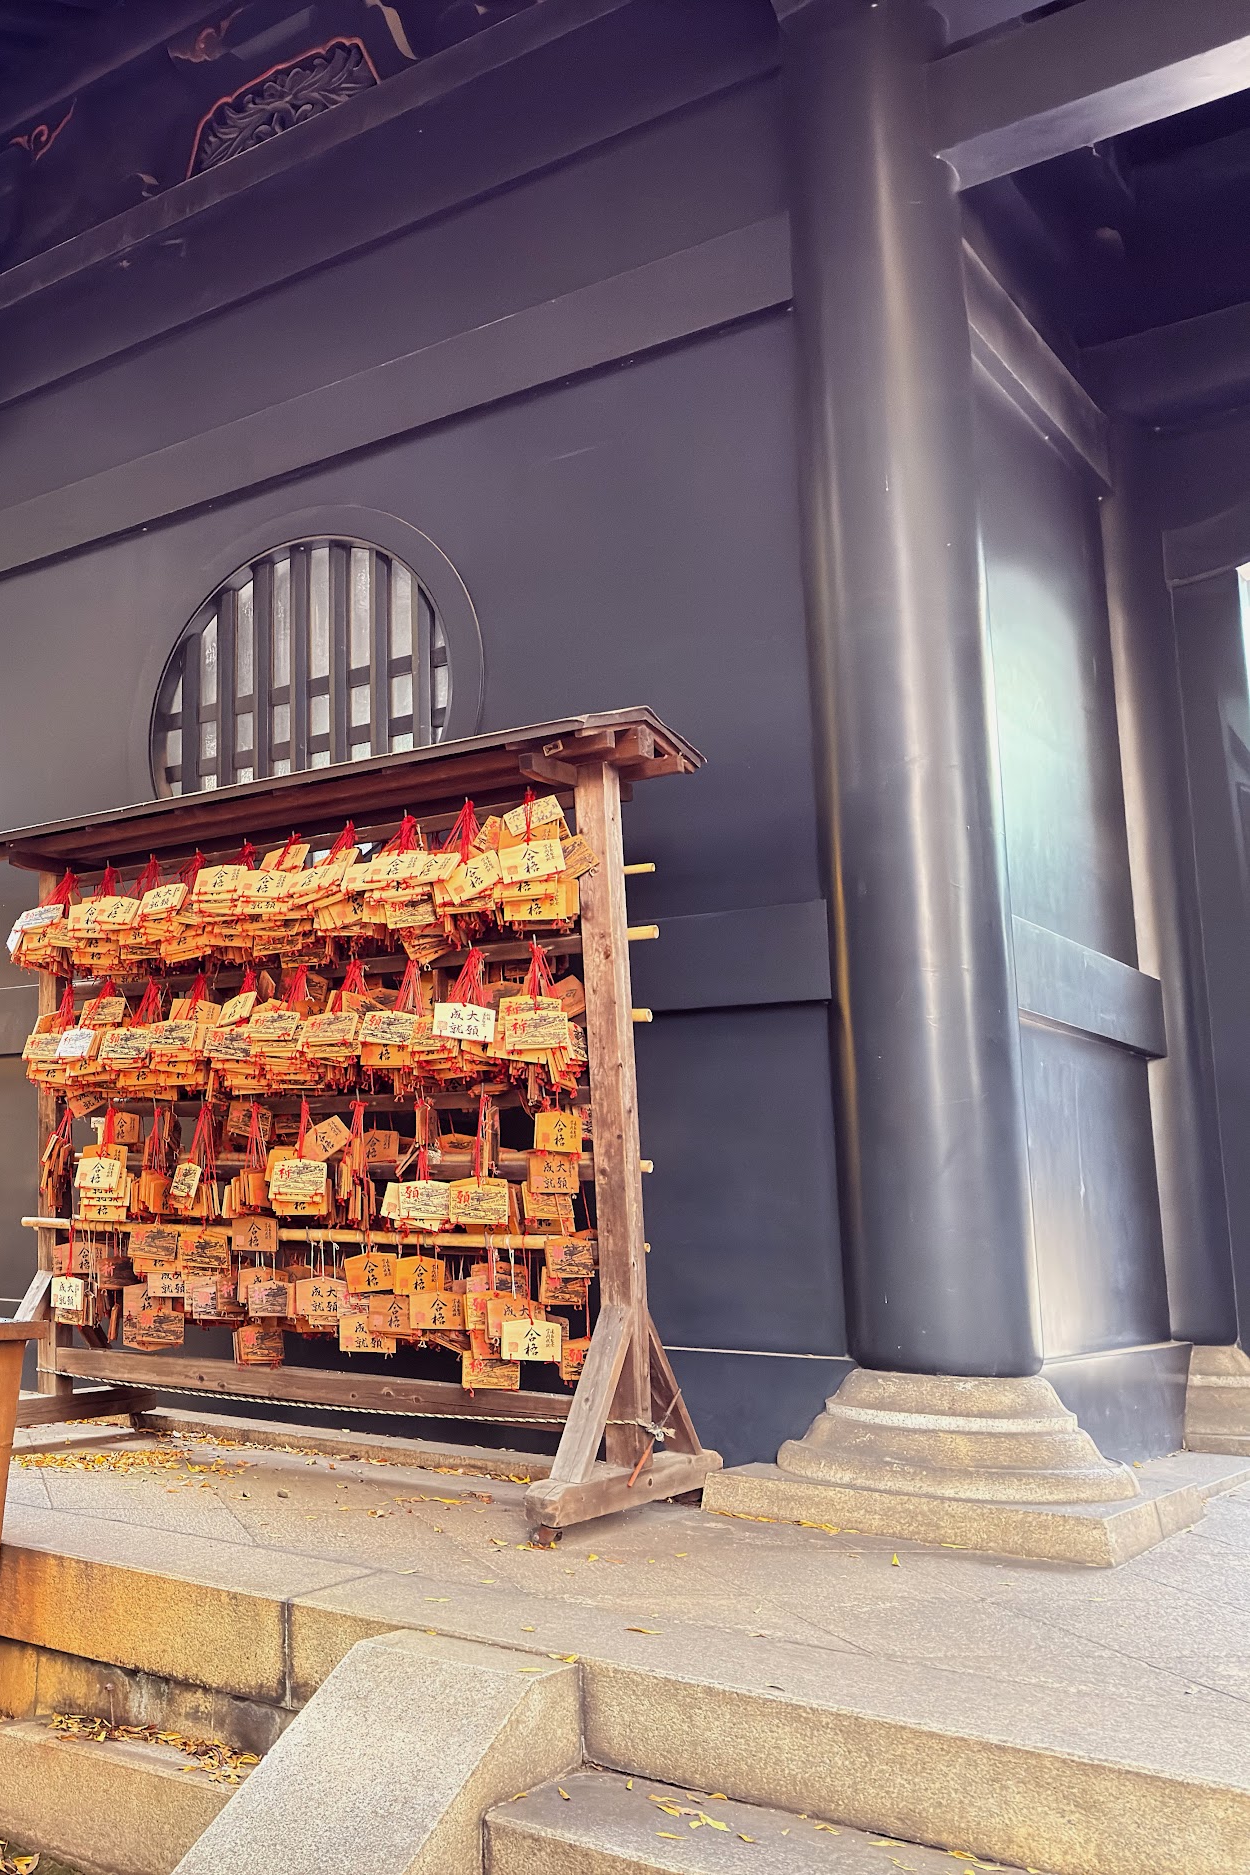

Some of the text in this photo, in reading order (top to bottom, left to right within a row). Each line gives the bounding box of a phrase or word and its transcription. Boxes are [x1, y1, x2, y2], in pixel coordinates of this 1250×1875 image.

[387, 858, 404, 875] 合格
[419, 858, 439, 877] 合格
[521, 848, 540, 874] 合格
[212, 869, 228, 888] 合格
[256, 874, 274, 893] 合格
[301, 870, 319, 888] 合格
[464, 866, 484, 889] 合格
[107, 901, 124, 919] 合格
[512, 1018, 527, 1035] 祈
[116, 1117, 127, 1140] 合格
[553, 1118, 567, 1147] 合格
[366, 1135, 380, 1160] 合格
[90, 1162, 105, 1184] 合格
[278, 1165, 292, 1180] 祈
[405, 1186, 419, 1200] 願
[456, 1190, 471, 1205] 願
[247, 1222, 262, 1248] 合格
[363, 1259, 380, 1287] 合格
[413, 1264, 429, 1291] 合格
[387, 1300, 403, 1328] 合格
[430, 1298, 448, 1326] 合格
[523, 1326, 542, 1357] 合格
